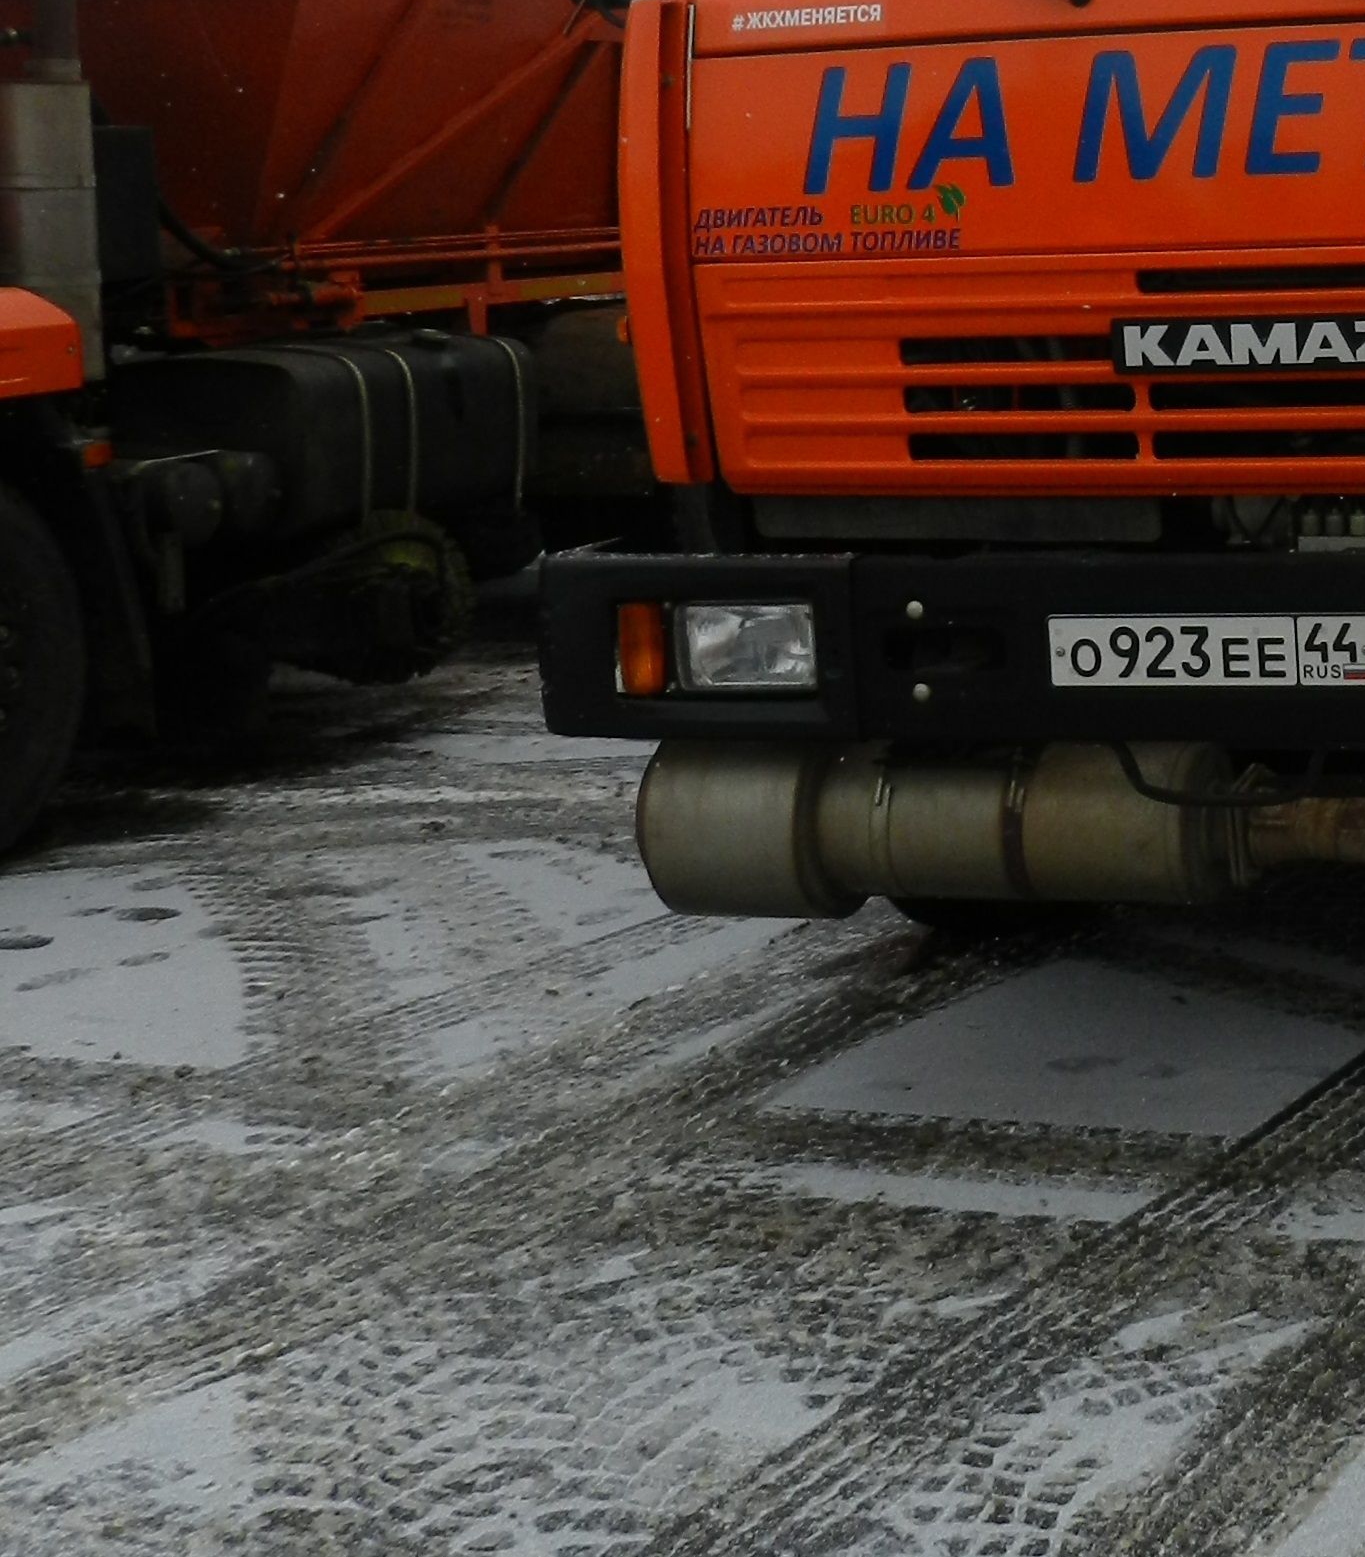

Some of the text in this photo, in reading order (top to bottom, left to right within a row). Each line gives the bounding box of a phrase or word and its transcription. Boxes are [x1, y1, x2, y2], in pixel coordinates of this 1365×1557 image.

[732, 4, 881, 31] #ЖКХМЕНЯЕТСЯ
[803, 57, 1015, 194] НА
[694, 206, 824, 232] ДВИГАТЕЛЬ
[851, 203, 936, 225] EURO 4
[694, 228, 961, 255] НА ГАЗОВОМ ТОПЛИВЕ
[1304, 623, 1358, 663] 44
[1303, 664, 1342, 679] RUS
